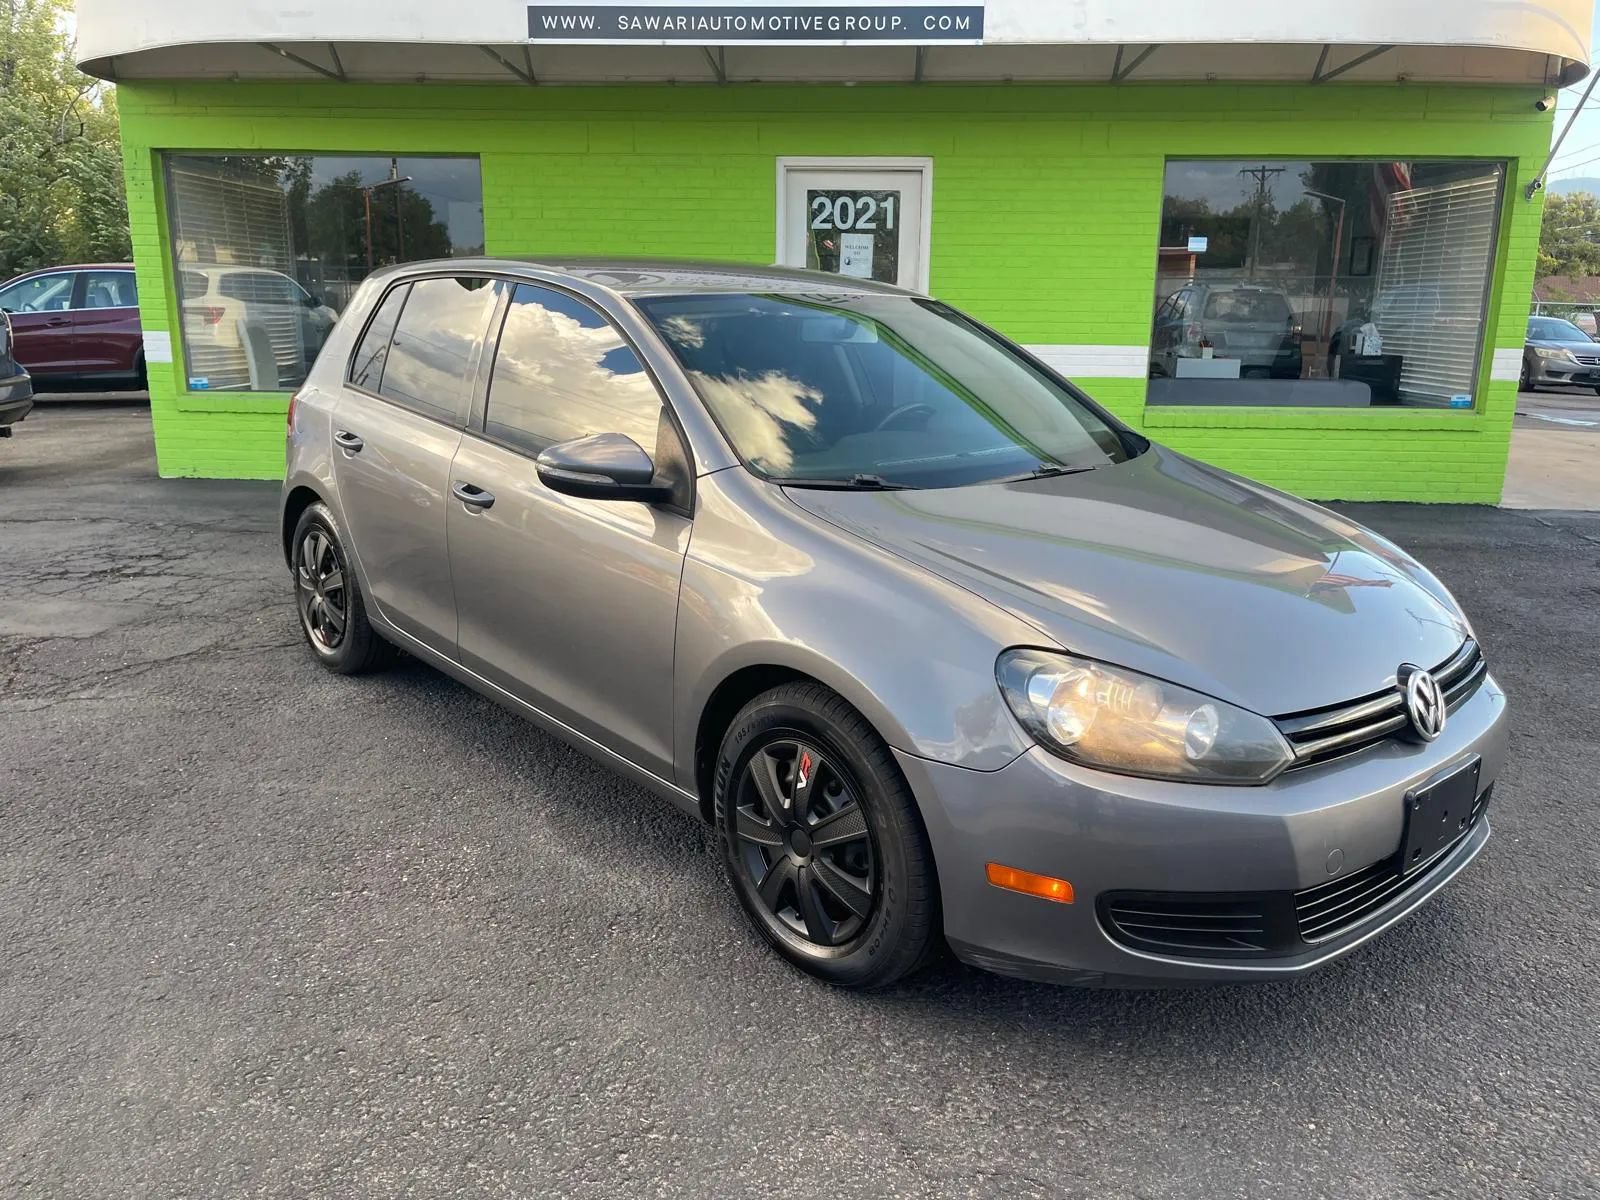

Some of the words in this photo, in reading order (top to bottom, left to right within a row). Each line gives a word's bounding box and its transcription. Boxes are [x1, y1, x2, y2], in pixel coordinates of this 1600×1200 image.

[541, 15, 601, 30] WWW.
[617, 15, 908, 31] SAWARIAUTOMOTIVEGROUP.
[923, 15, 970, 30] COM
[811, 196, 894, 230] 2021
